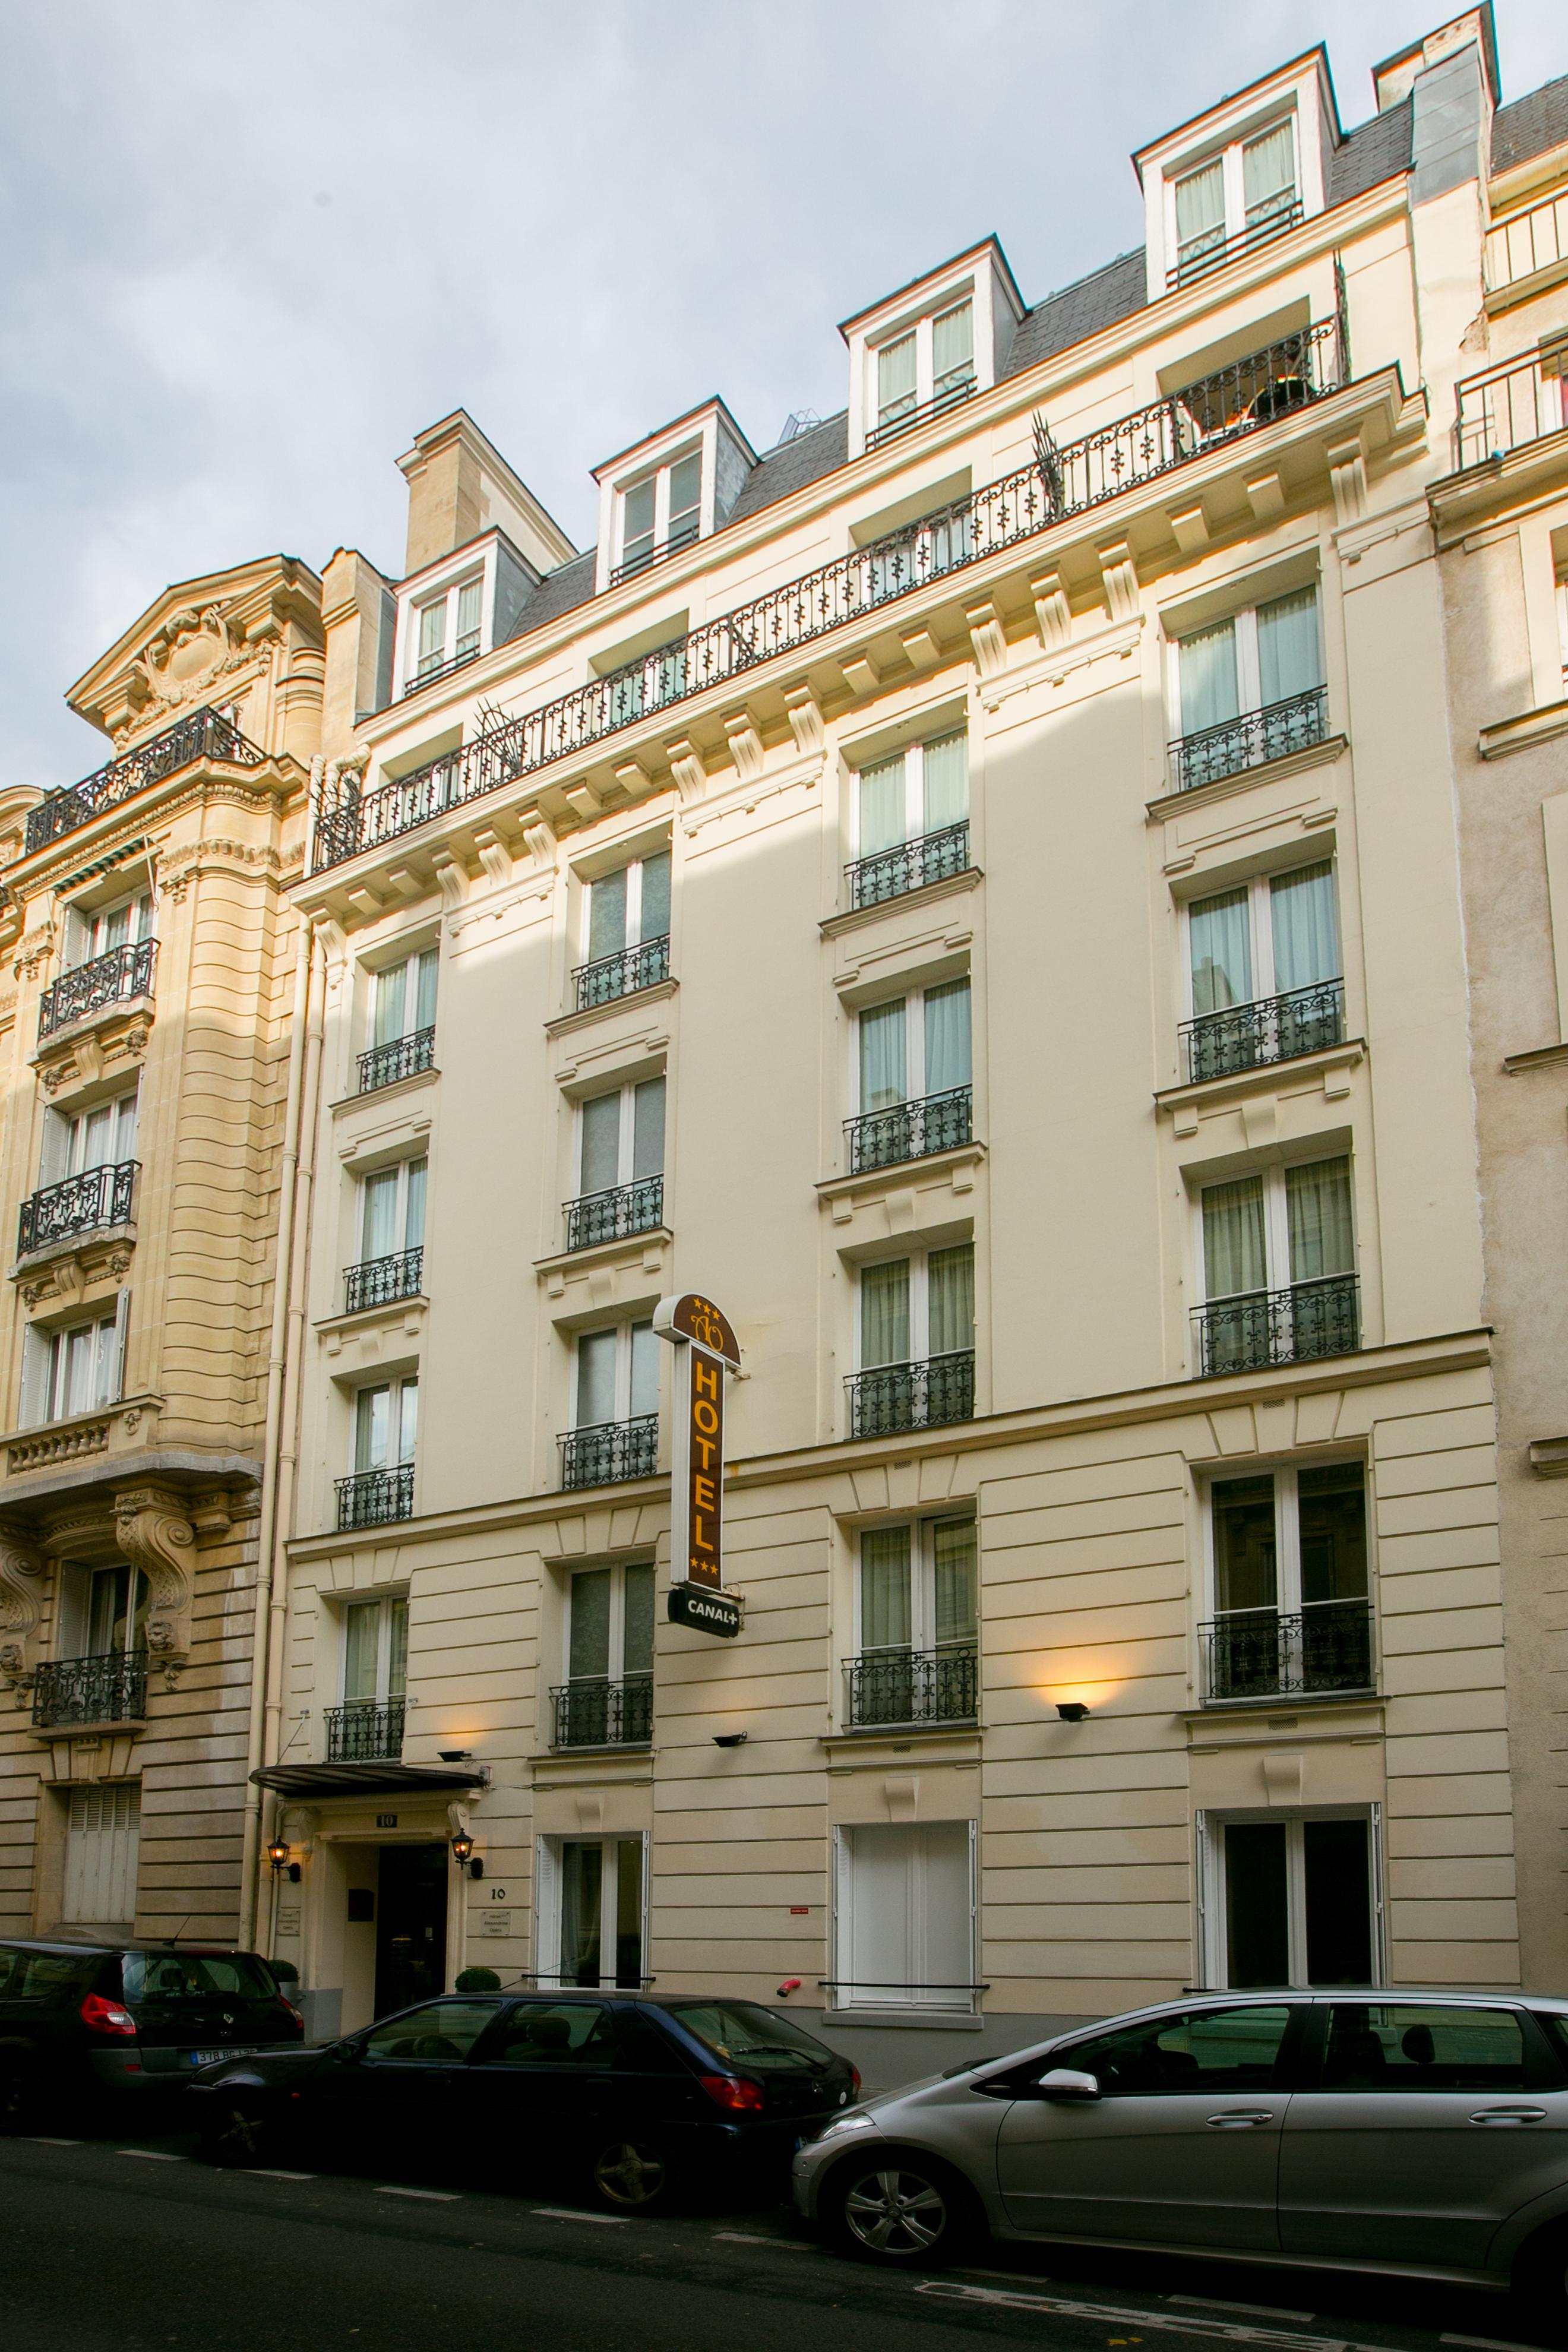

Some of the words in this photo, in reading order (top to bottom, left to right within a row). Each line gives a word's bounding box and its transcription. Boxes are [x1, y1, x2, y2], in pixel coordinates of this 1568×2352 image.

[694, 1361, 719, 1552] HOTEL
[688, 1599, 738, 1625] CANAL+
[381, 1815, 394, 1826] 10
[492, 1888, 506, 1899] 10
